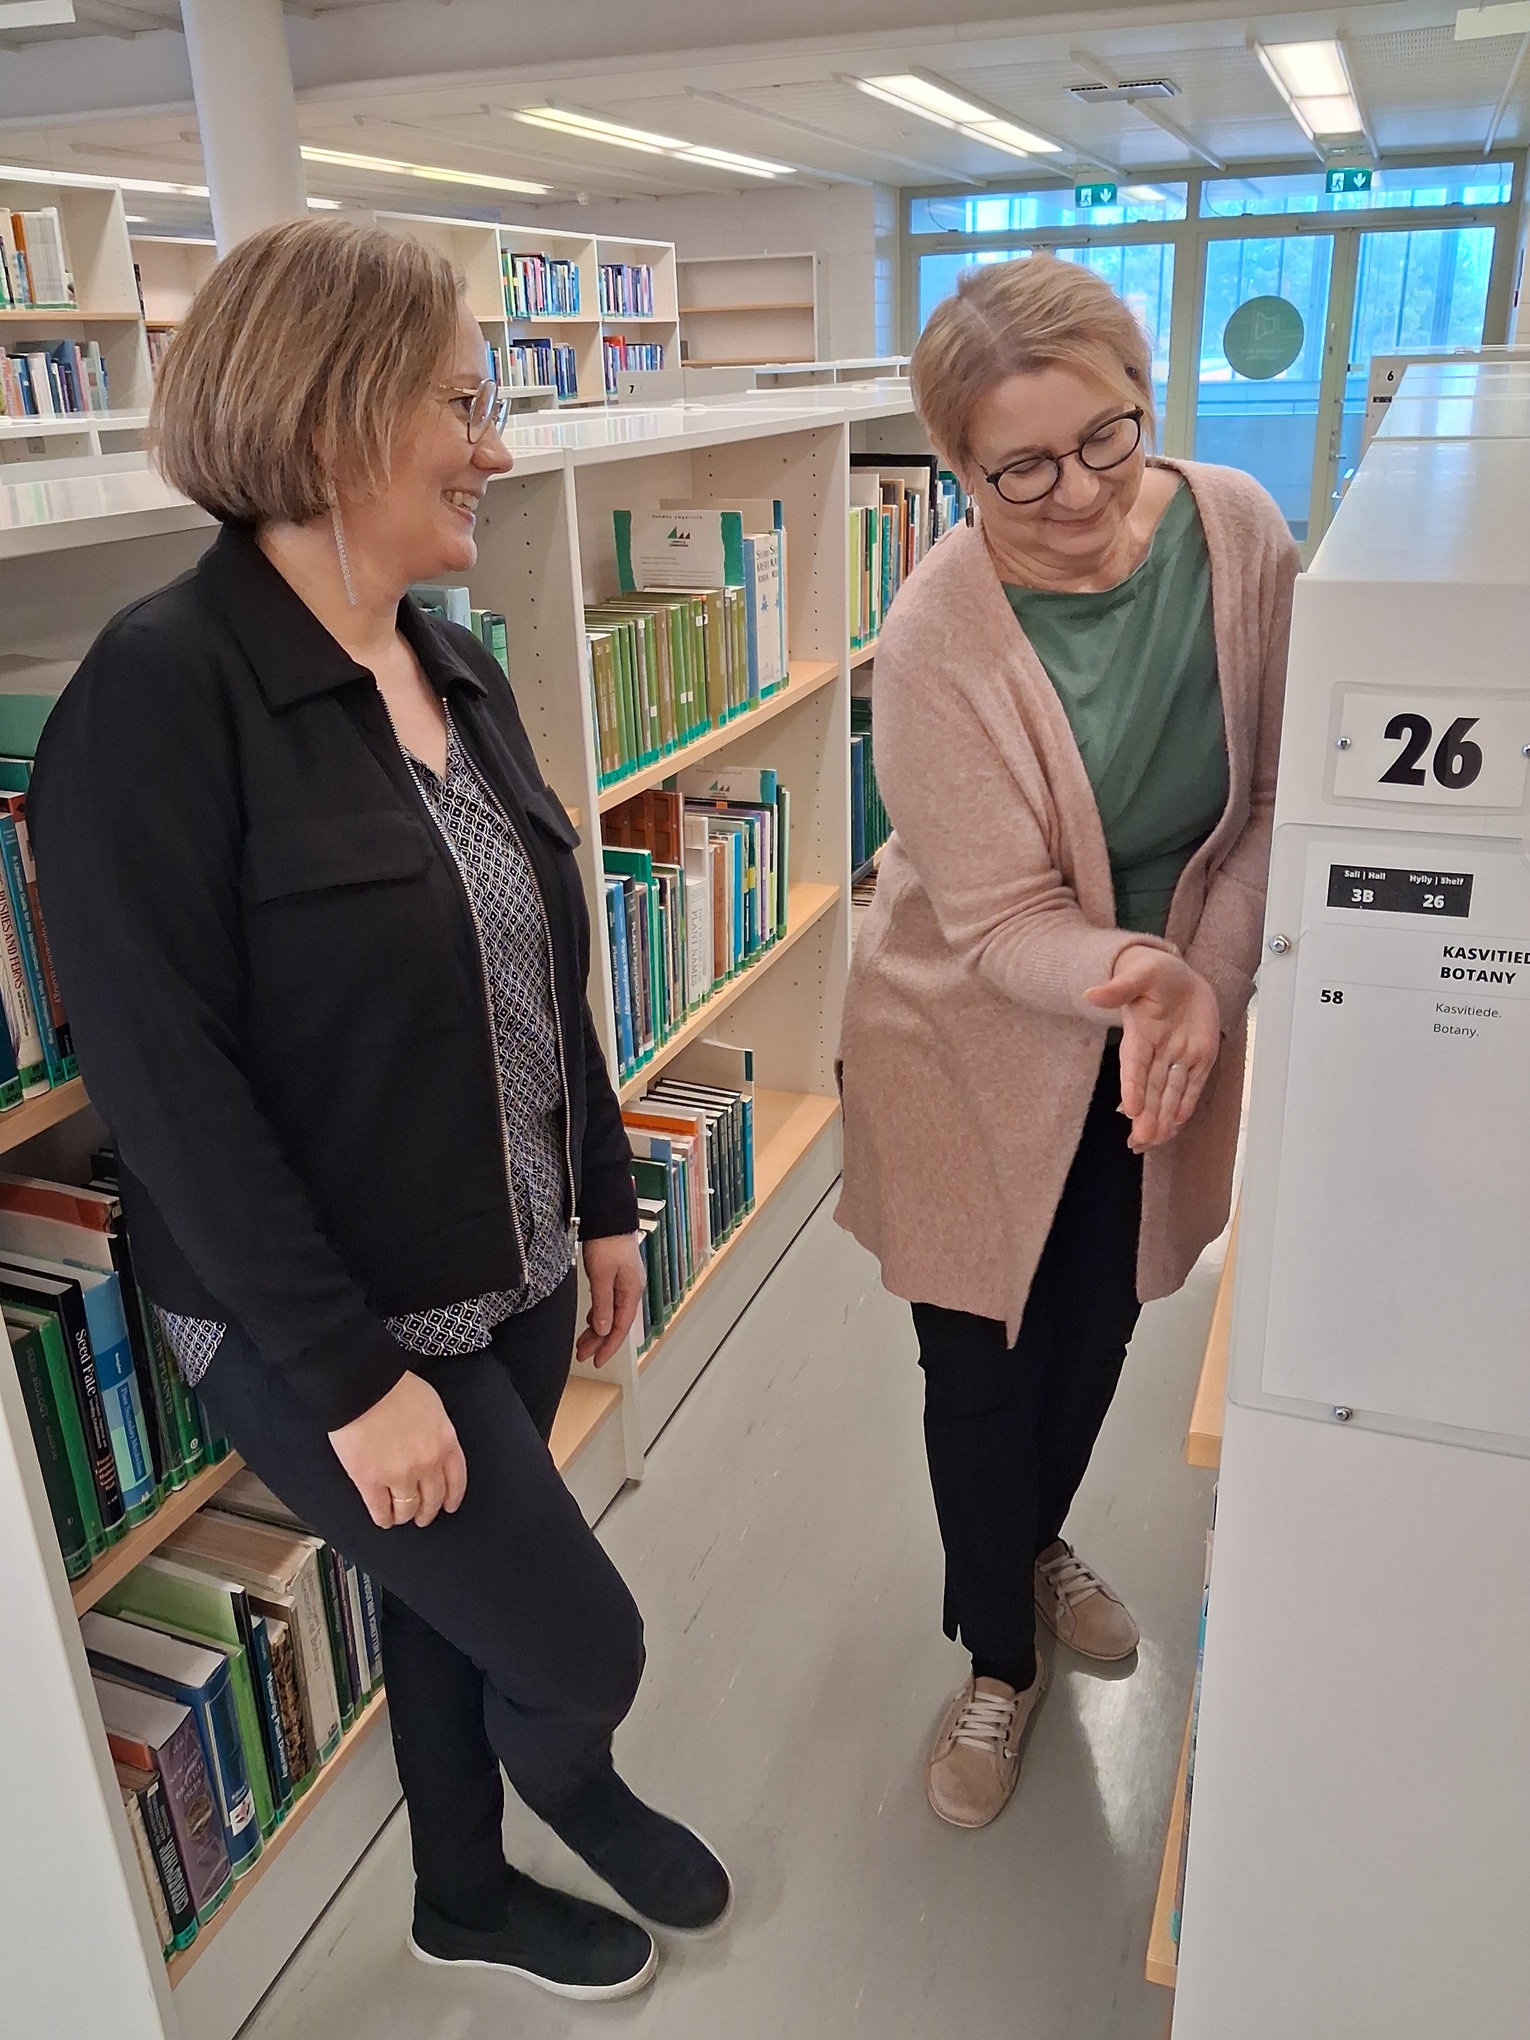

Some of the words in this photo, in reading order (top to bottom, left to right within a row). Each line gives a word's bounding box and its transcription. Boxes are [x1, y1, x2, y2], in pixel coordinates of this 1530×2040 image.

[1387, 370, 1394, 381] 6
[629, 384, 635, 394] 7
[1377, 712, 1483, 790] 26
[1344, 870, 1360, 879] Sali
[1368, 872, 1386, 880] Hall
[1409, 874, 1432, 886] Hylly
[1440, 877, 1464, 886] Shelf
[1351, 888, 1374, 903] 3B
[1422, 894, 1445, 908] 26
[5, 932, 18, 955] AND
[1443, 946, 1530, 964] KASVITIED
[9, 955, 25, 989] FERNS
[1440, 966, 1516, 984] BOTANY
[613, 970, 621, 1014] Physiology
[622, 964, 631, 1015] Physiology
[1320, 990, 1344, 1005] 58
[1435, 1003, 1501, 1018] Kasvitiede.
[1433, 1023, 1479, 1039] Botany.
[75, 1328, 91, 1365] Seed
[82, 1363, 97, 1397] Fate
[159, 1360, 173, 1415] PLANTS
